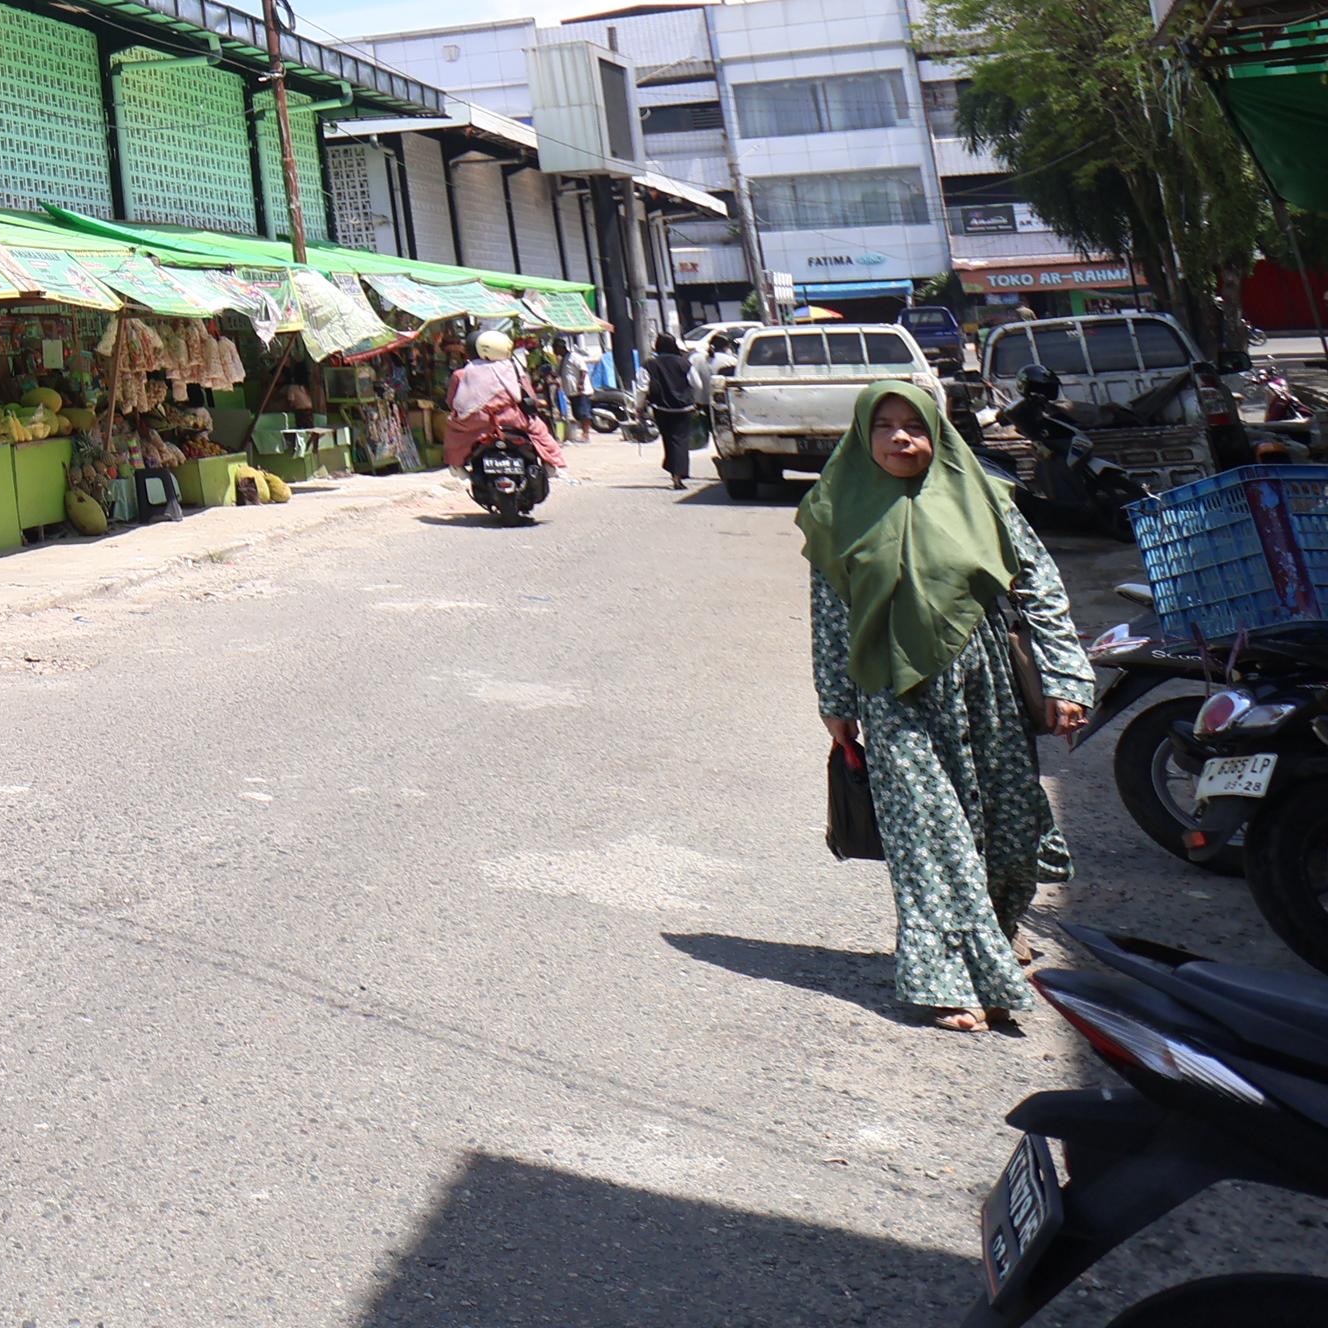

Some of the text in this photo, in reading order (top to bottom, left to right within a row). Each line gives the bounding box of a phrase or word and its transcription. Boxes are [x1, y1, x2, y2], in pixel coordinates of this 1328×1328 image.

[807, 255, 855, 267] FATIMA
[987, 273, 1034, 287] TOKO
[1251, 757, 1270, 774] LP
